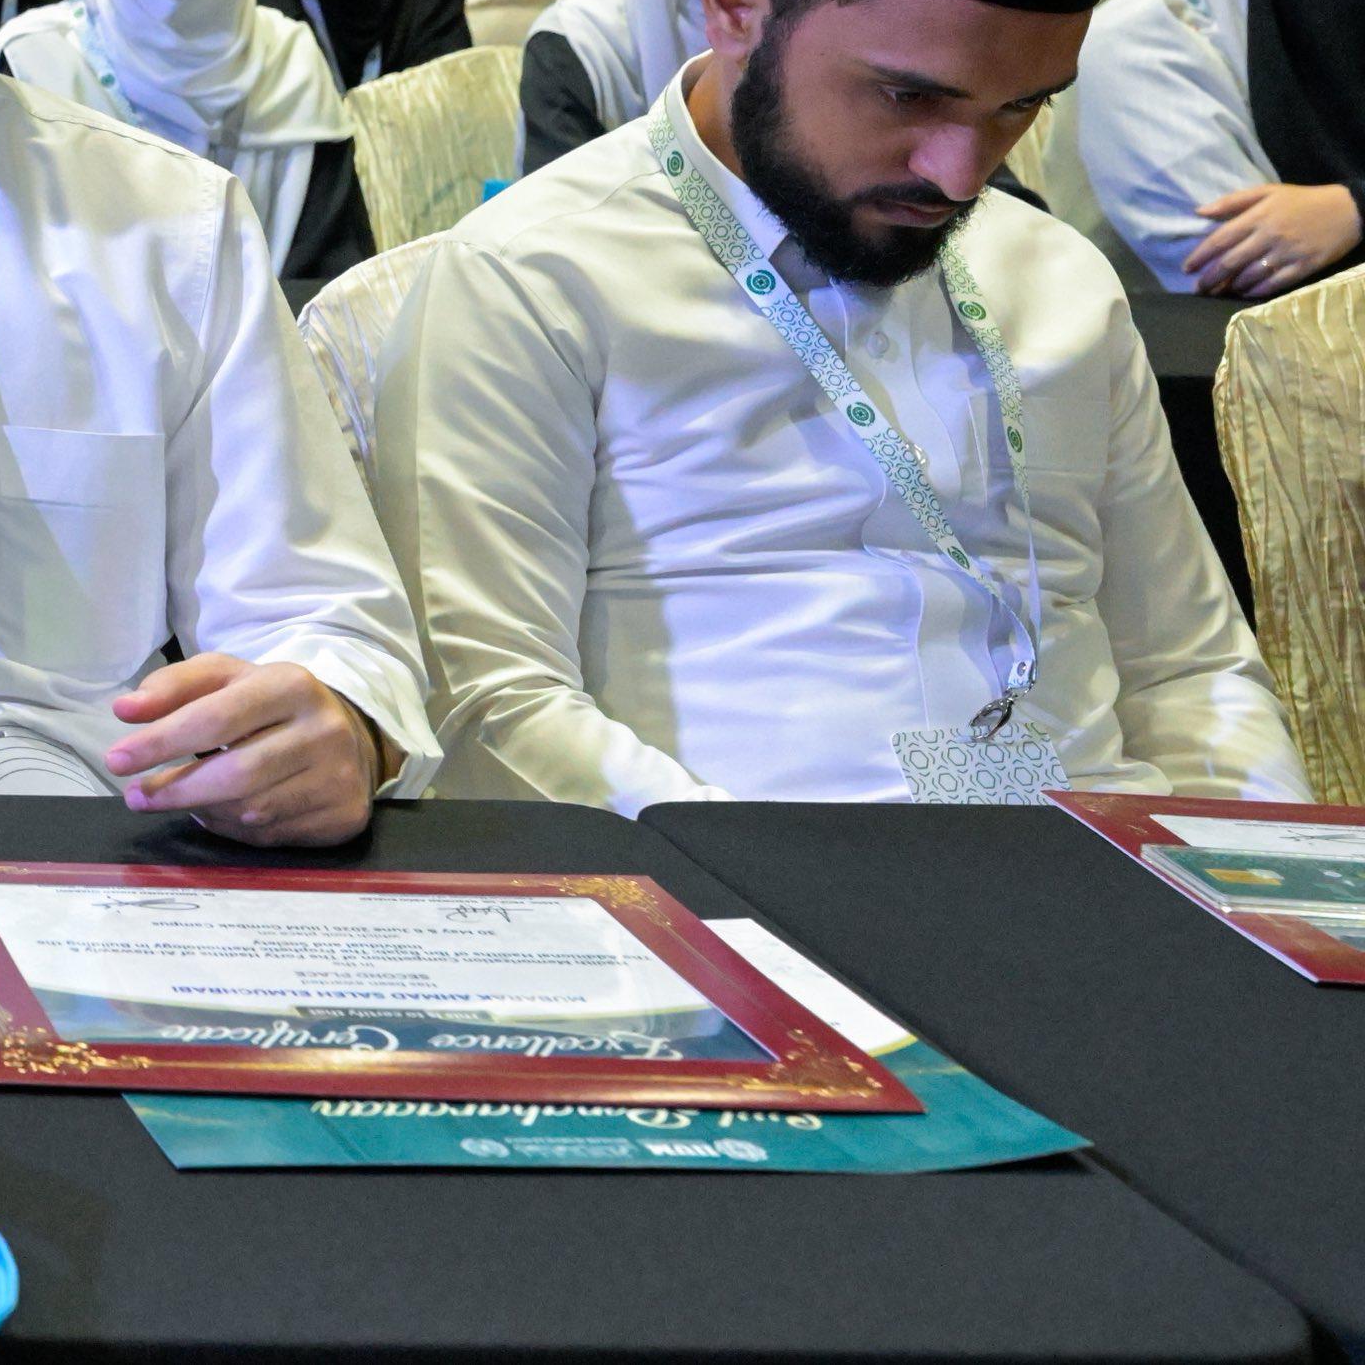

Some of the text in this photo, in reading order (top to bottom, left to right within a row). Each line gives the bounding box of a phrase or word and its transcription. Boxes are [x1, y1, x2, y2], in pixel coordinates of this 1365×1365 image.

[66, 939, 130, 948] Building
[154, 942, 254, 951] Methodology
[251, 939, 307, 947] Society
[258, 945, 334, 953] Prophetic
[359, 954, 458, 963] Competition
[536, 952, 618, 960] Additional
[462, 957, 571, 965] Memorization
[293, 970, 430, 980] SECOND PLACE
[316, 990, 385, 999] SALEH
[390, 992, 472, 1001] AHMAD
[477, 992, 587, 1004] MUBARAK
[308, 1009, 345, 1017] that
[347, 1009, 403, 1019] certify
[161, 1021, 683, 1060] Excellence Certificate
